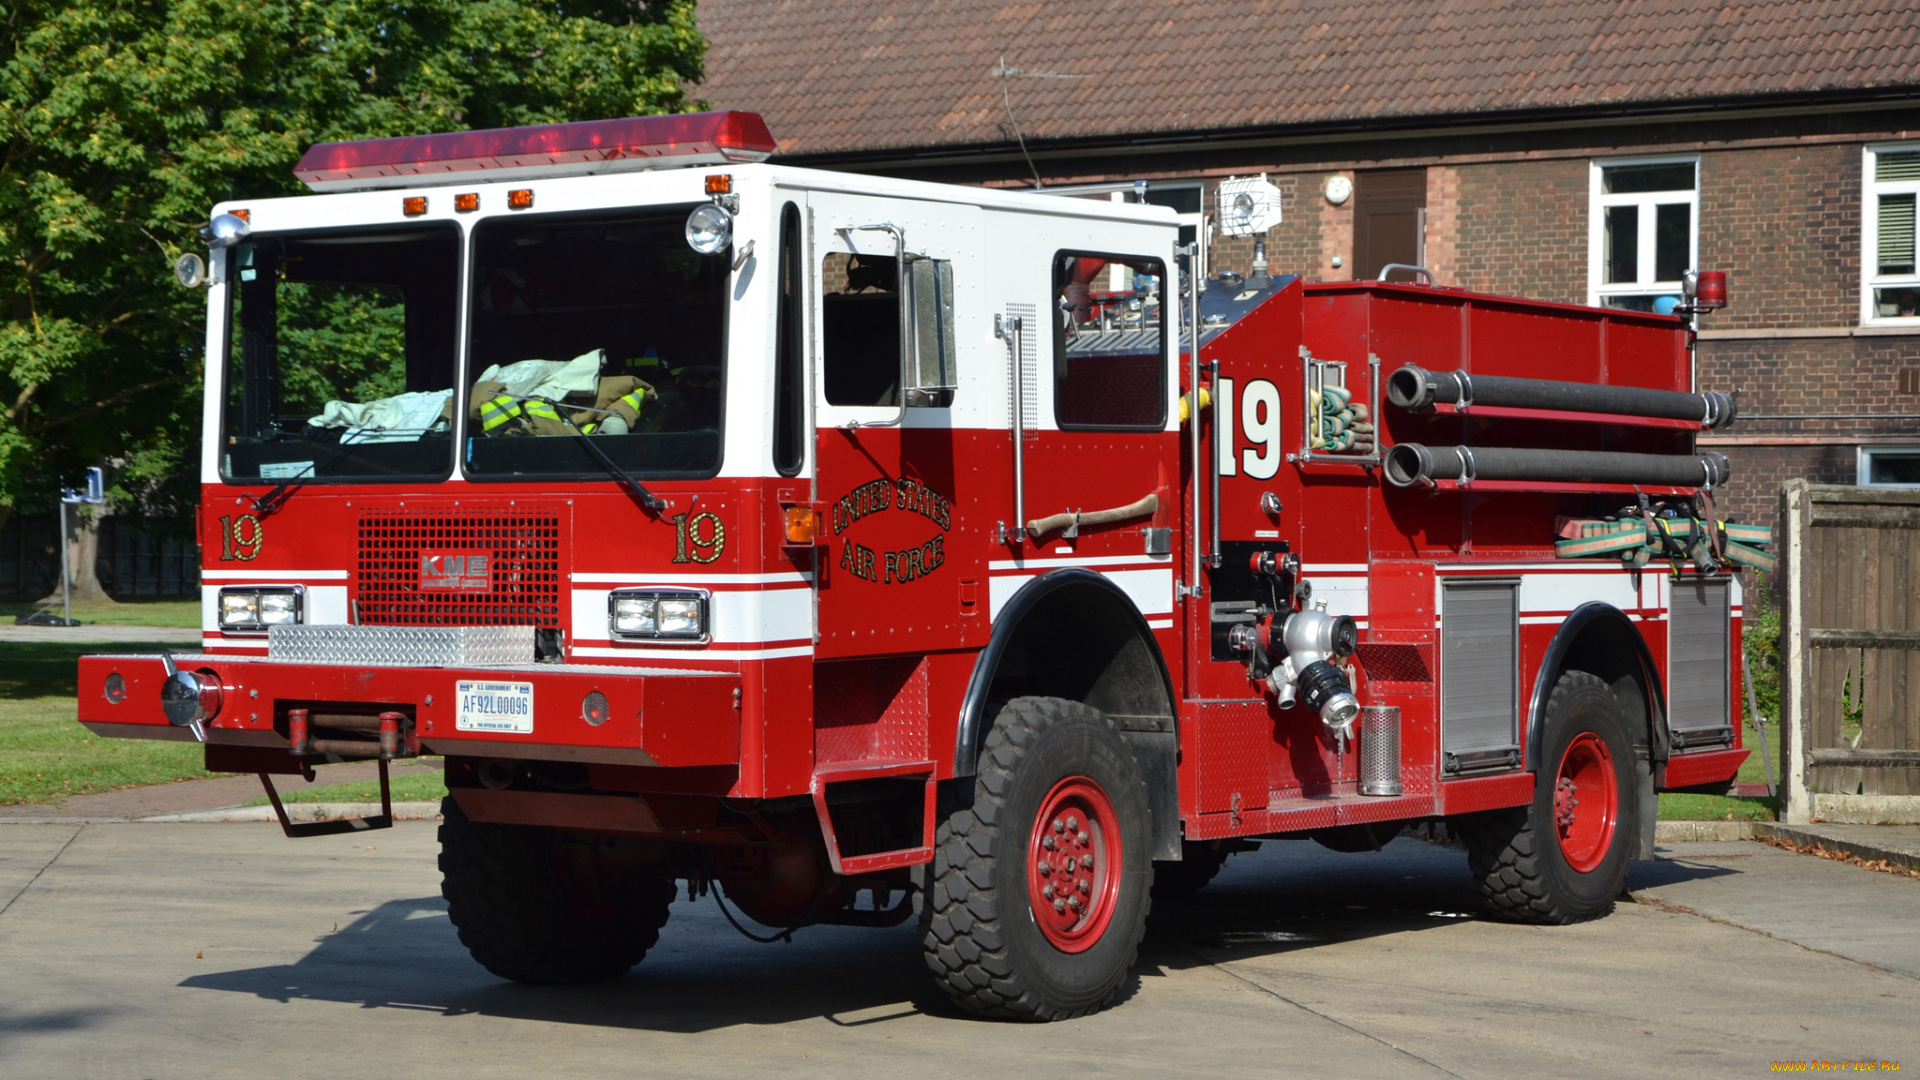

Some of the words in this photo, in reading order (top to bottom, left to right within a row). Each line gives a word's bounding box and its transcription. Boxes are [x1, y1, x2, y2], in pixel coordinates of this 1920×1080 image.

[1218, 376, 1282, 481] 19
[833, 478, 891, 535] UNITED
[896, 477, 951, 532] STATES
[218, 513, 264, 561] 19
[671, 511, 726, 564] 19
[840, 538, 878, 583] AIR
[884, 533, 945, 584] FORCE
[421, 555, 489, 577] KME
[462, 695, 528, 716] AF92L00096
[485, 684, 512, 692] GOVERNMENT
